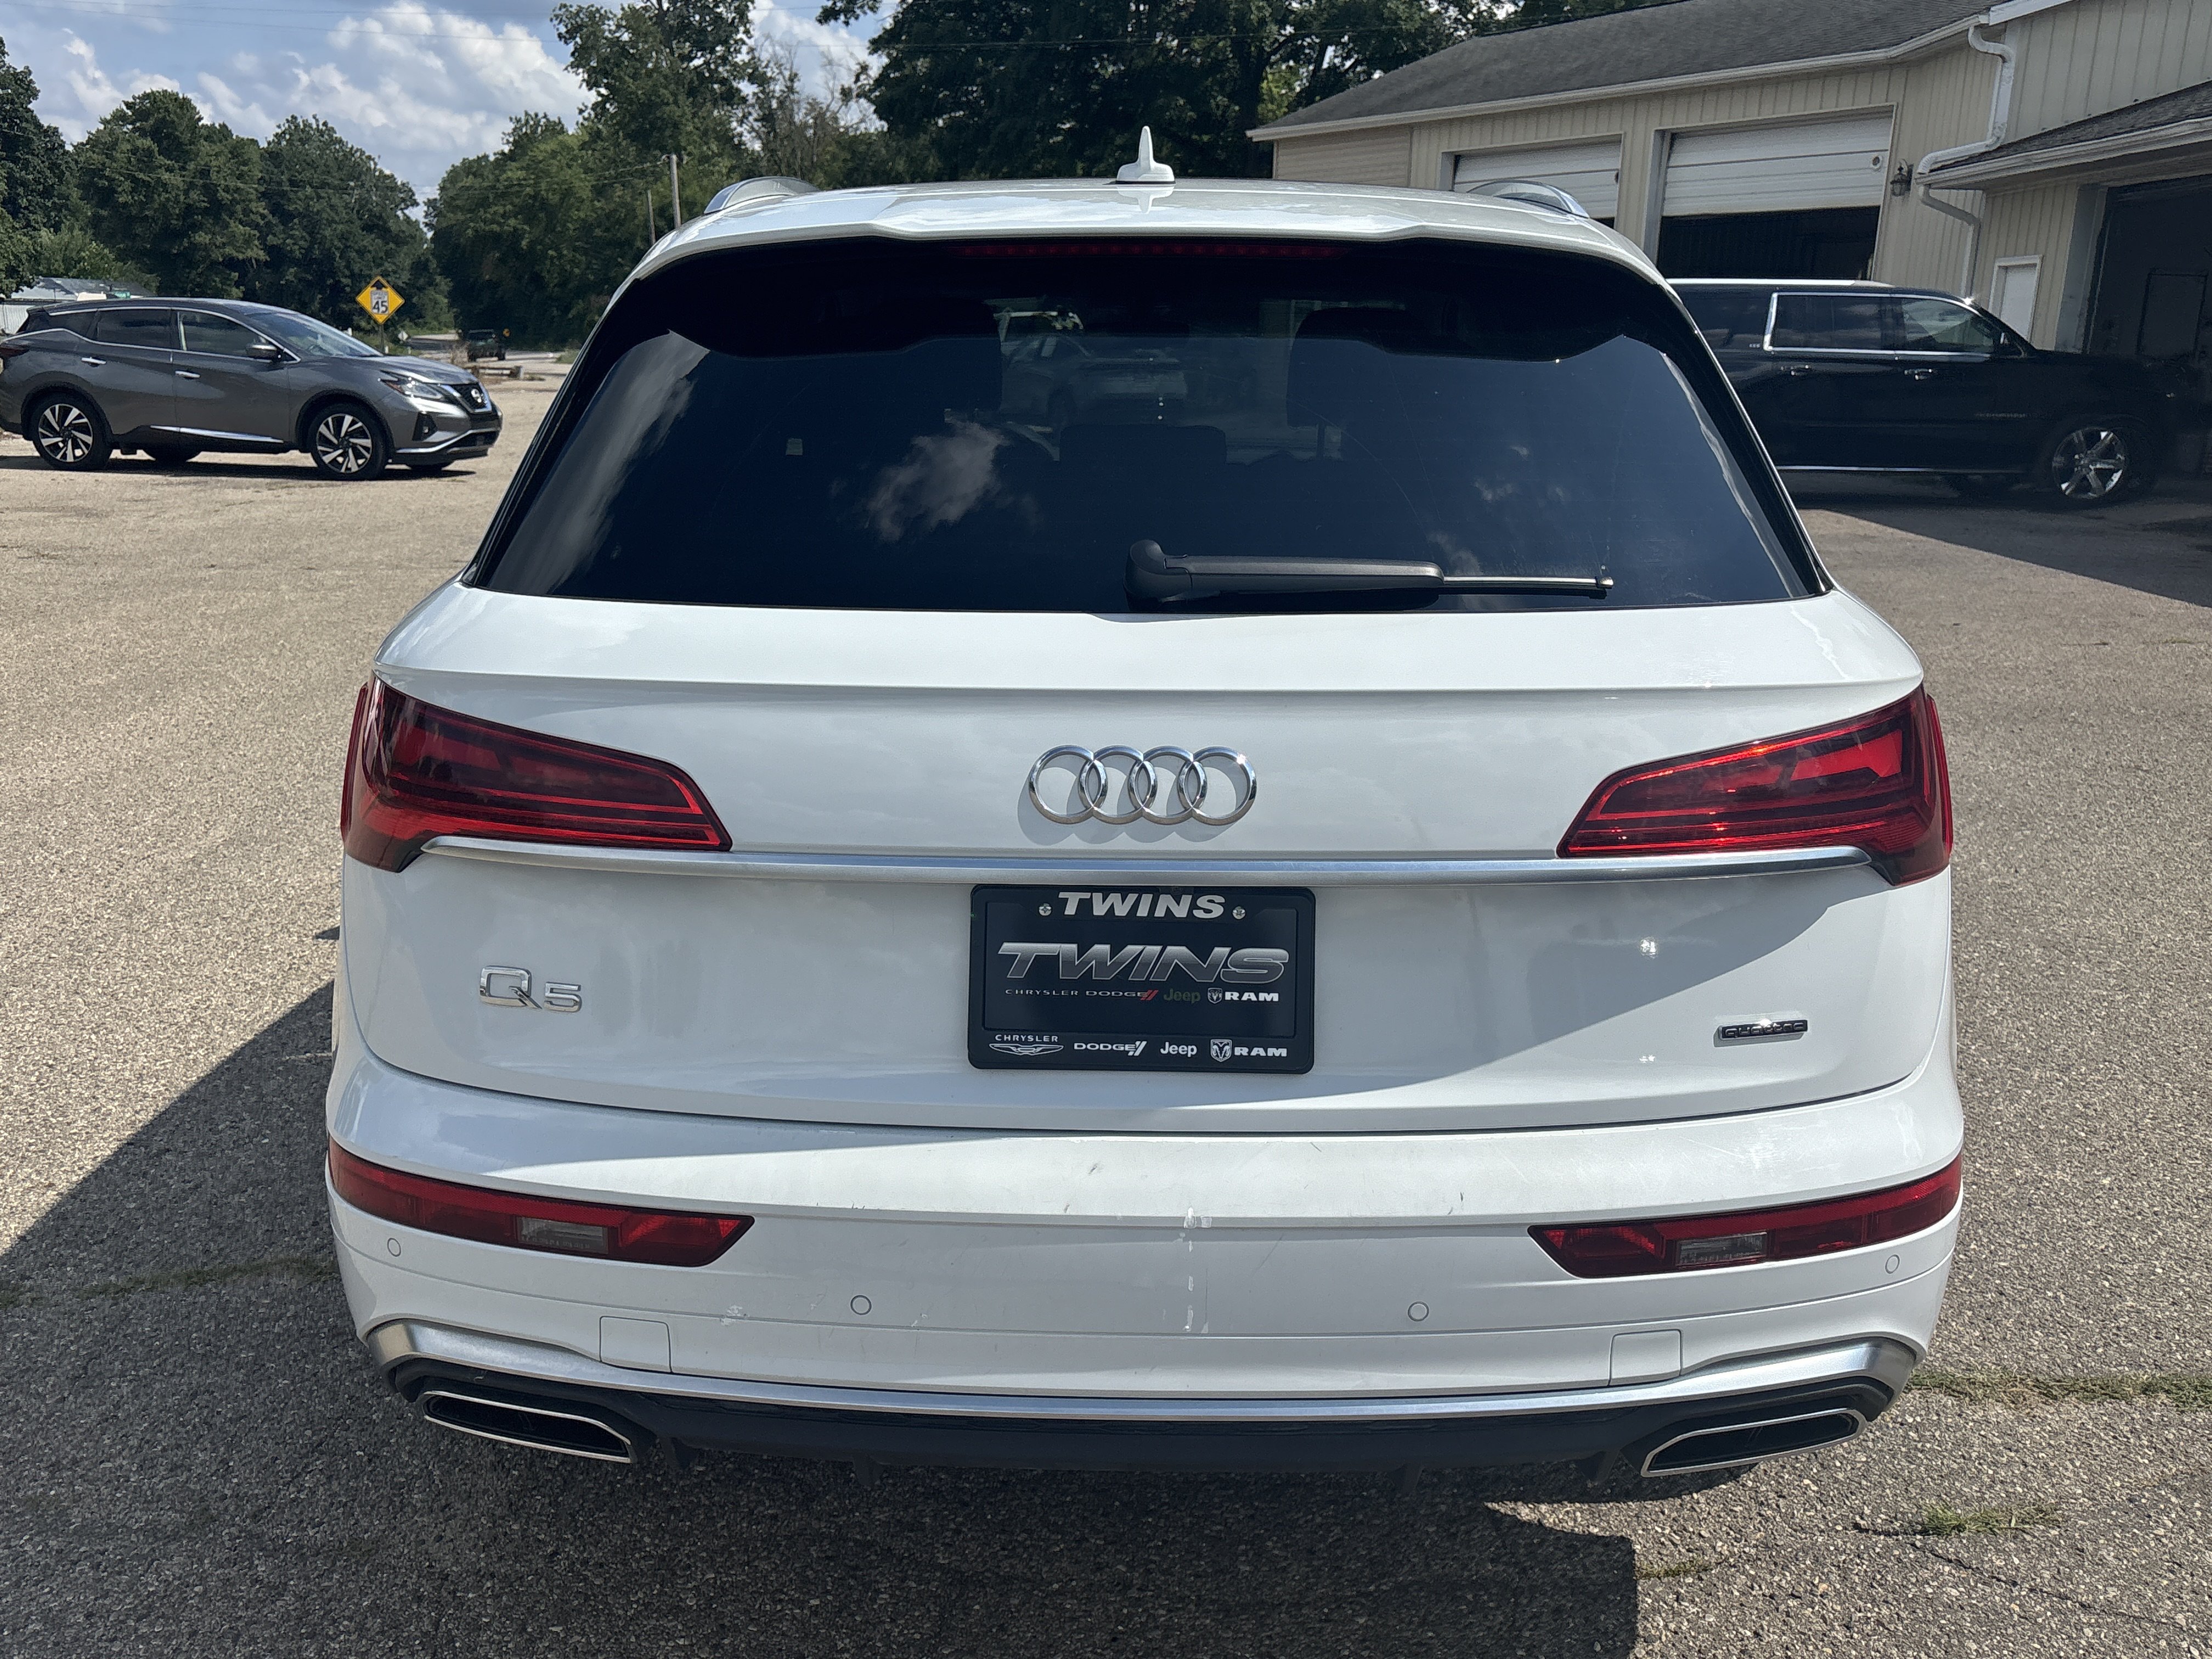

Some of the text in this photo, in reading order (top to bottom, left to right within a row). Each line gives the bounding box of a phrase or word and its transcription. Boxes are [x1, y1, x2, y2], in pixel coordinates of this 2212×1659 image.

[372, 300, 388, 313] 45
[1058, 892, 1225, 918] TWINS
[998, 942, 1289, 984] TWINS
[479, 965, 582, 1013] Q5
[1163, 989, 1201, 1003] Jeep
[1224, 991, 1279, 1002] RAM
[995, 1034, 1287, 1057] CHRYSLER DODGE Jeep RAM
